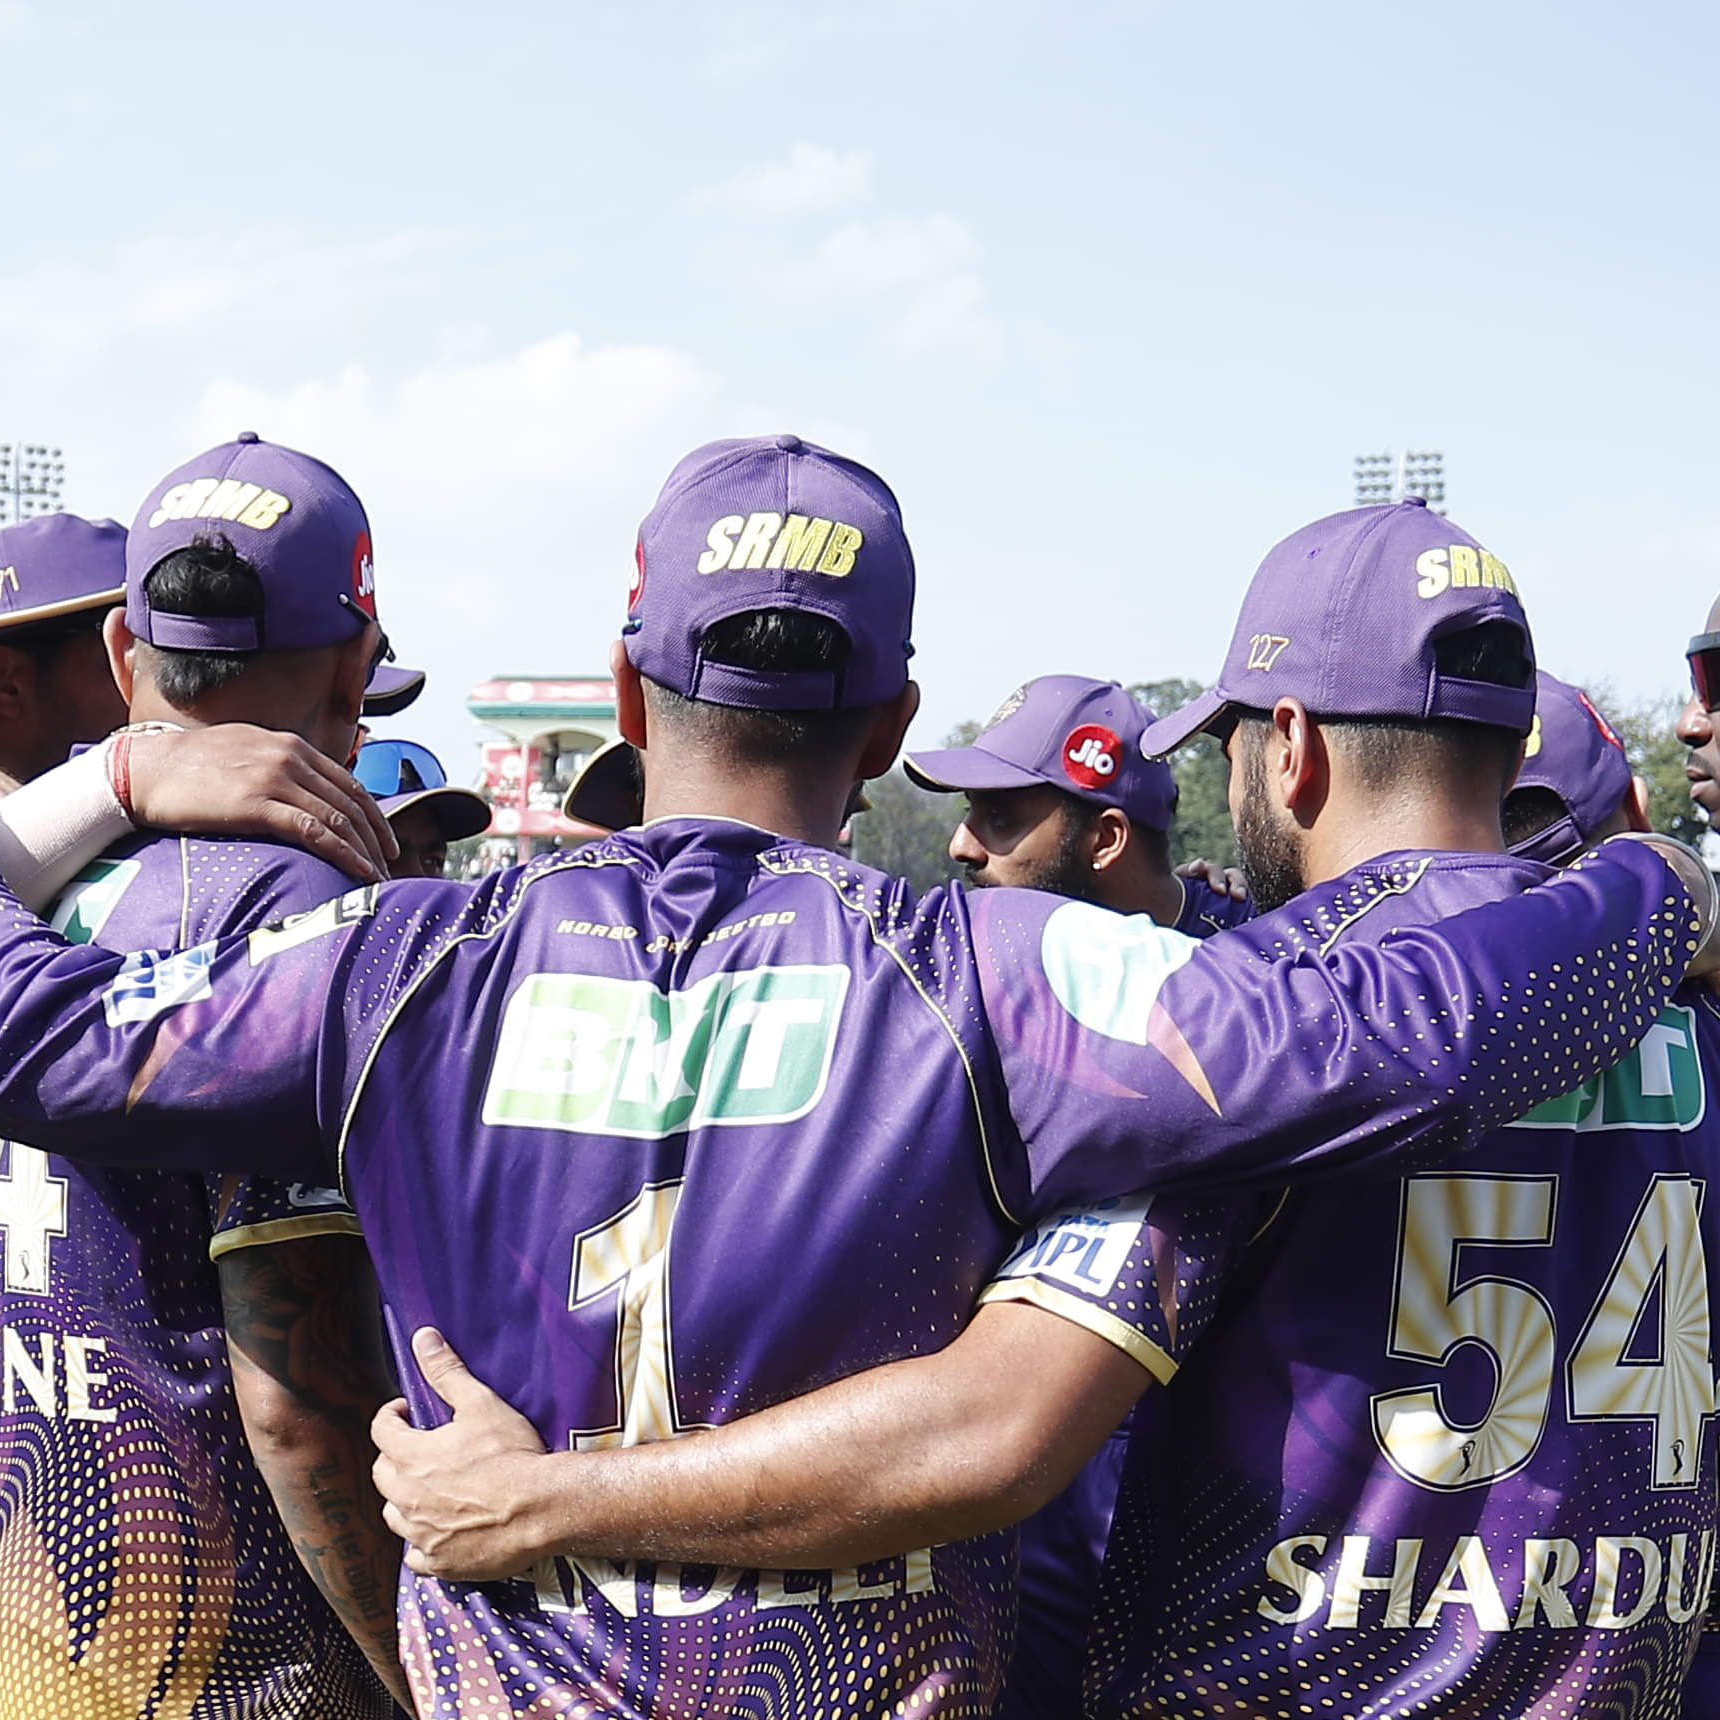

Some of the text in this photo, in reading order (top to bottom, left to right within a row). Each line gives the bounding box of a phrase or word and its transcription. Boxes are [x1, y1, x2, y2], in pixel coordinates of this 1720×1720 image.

[697, 512, 863, 577] SRMB
[1247, 634, 1290, 672] 127
[1069, 738, 1115, 775] Jio
[1029, 1231, 1107, 1285] IPL
[568, 1177, 719, 1454] 1
[1256, 1526, 1716, 1632] SHARDU
